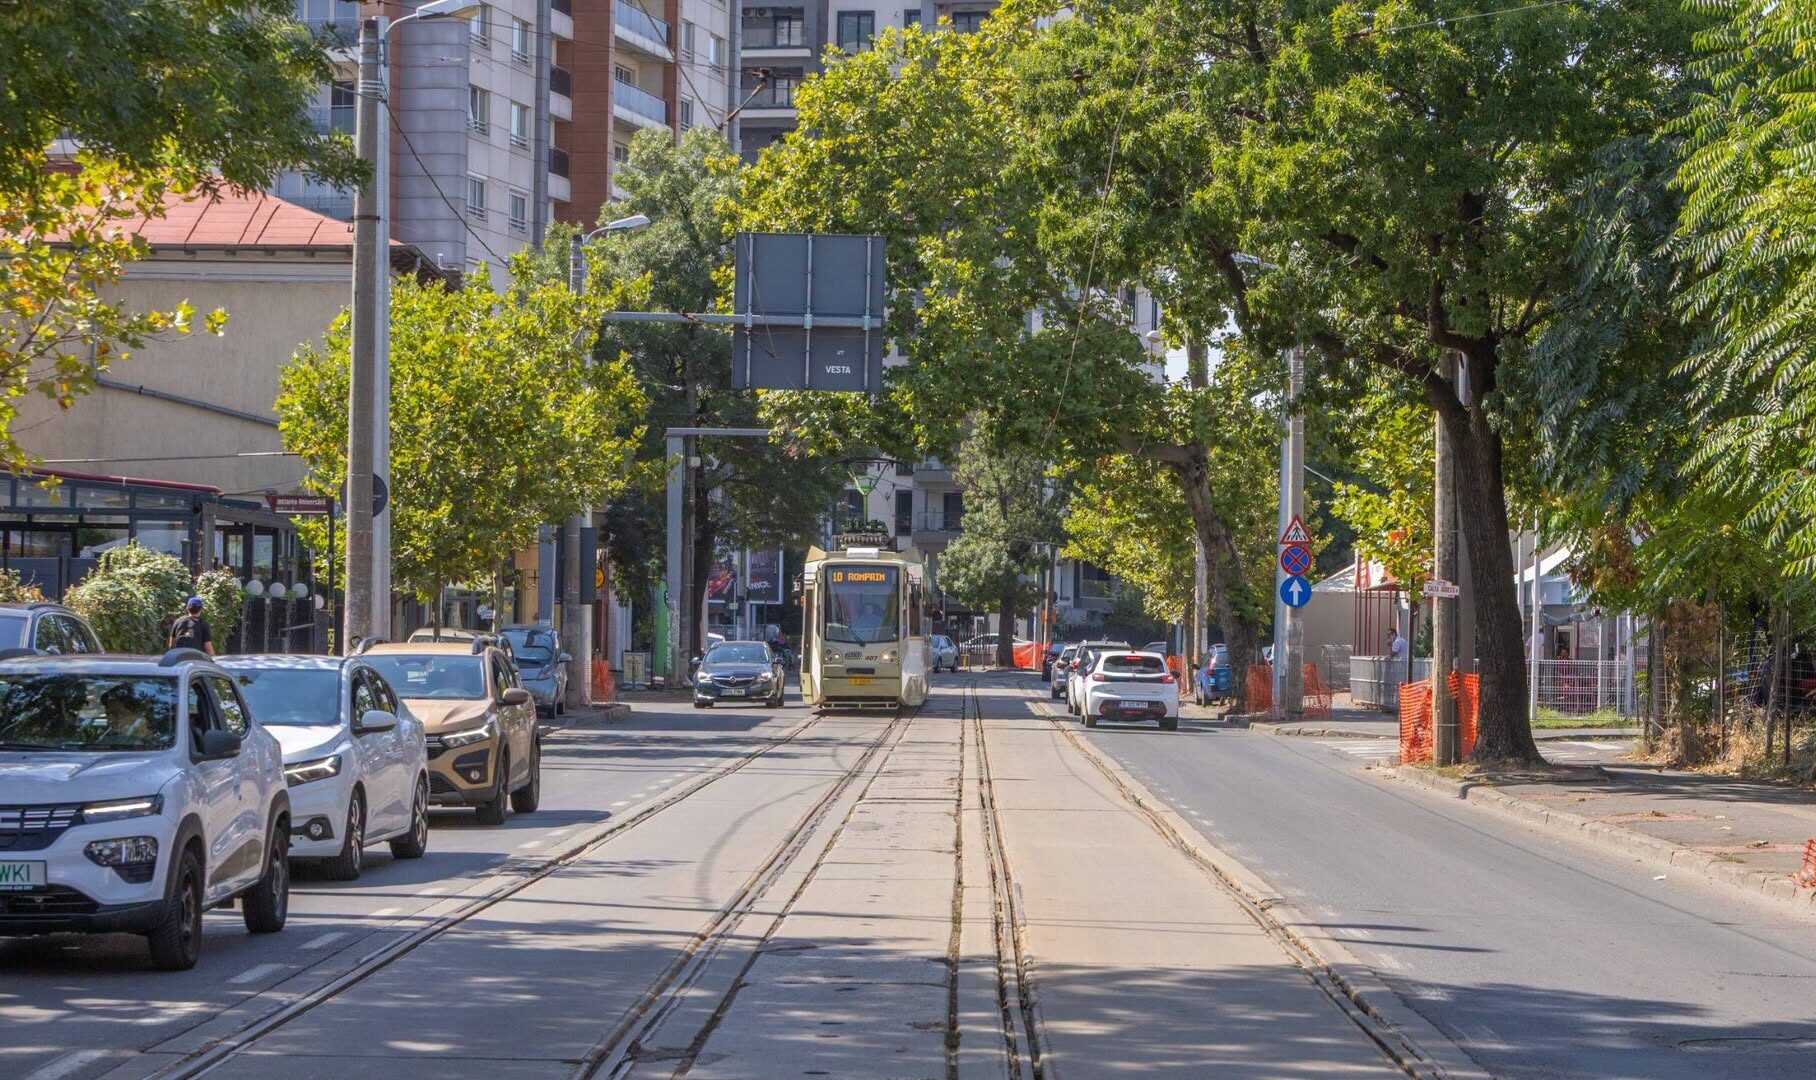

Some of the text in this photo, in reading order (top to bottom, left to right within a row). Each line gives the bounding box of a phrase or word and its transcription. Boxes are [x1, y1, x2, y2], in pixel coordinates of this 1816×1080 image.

[825, 365, 851, 374] VESTA
[832, 571, 886, 582] 10 ROMPRIM
